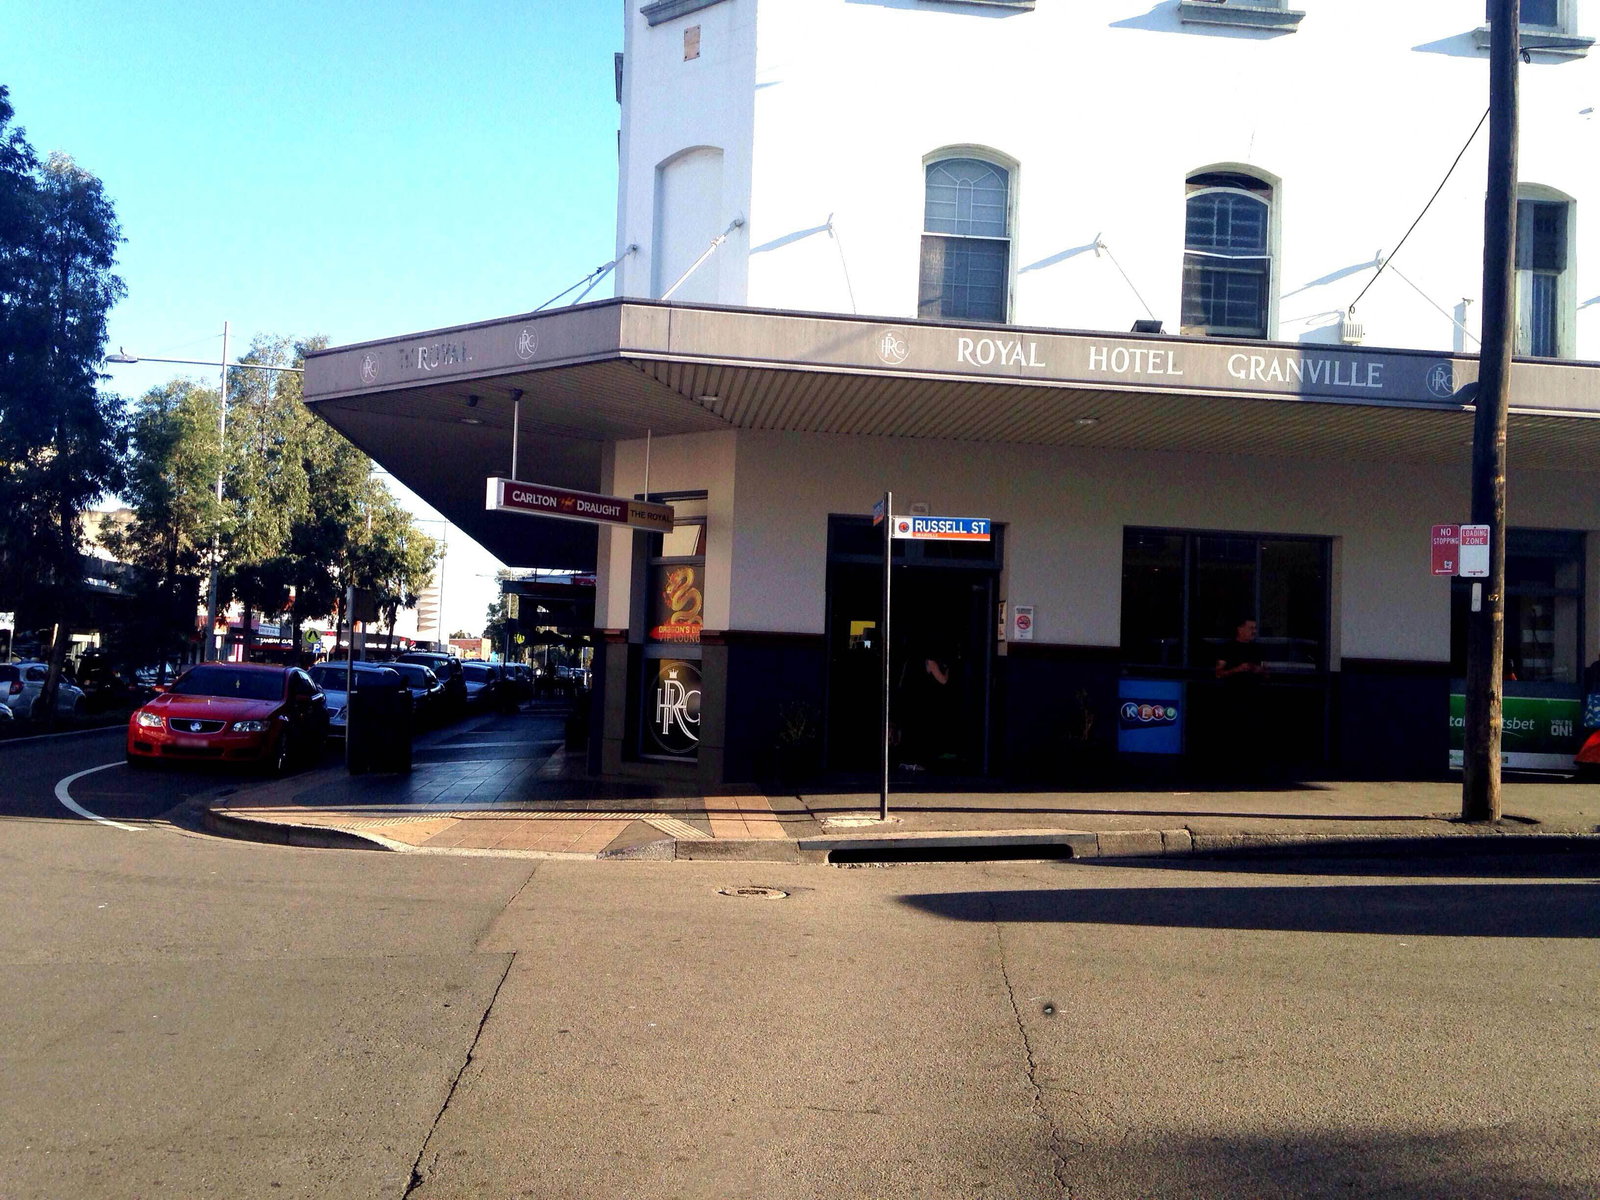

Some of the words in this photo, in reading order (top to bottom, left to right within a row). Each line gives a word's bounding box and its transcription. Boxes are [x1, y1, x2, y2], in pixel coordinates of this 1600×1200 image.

[956, 337, 1046, 368] ROYAL
[1088, 345, 1184, 376] HOTEL
[1226, 353, 1384, 388] GRANVILLE
[512, 490, 557, 508] CARLTON
[576, 499, 621, 517] DRAUGHT
[630, 509, 646, 519] THE
[915, 520, 967, 533] RUSSELL
[971, 521, 986, 534] ST
[1440, 527, 1452, 536] NO
[1462, 529, 1487, 537] LOADING
[1433, 537, 1459, 545] STOPPING
[1465, 537, 1484, 545] ZONE
[673, 634, 701, 643] LOUNG
[1550, 725, 1573, 737] ON!
